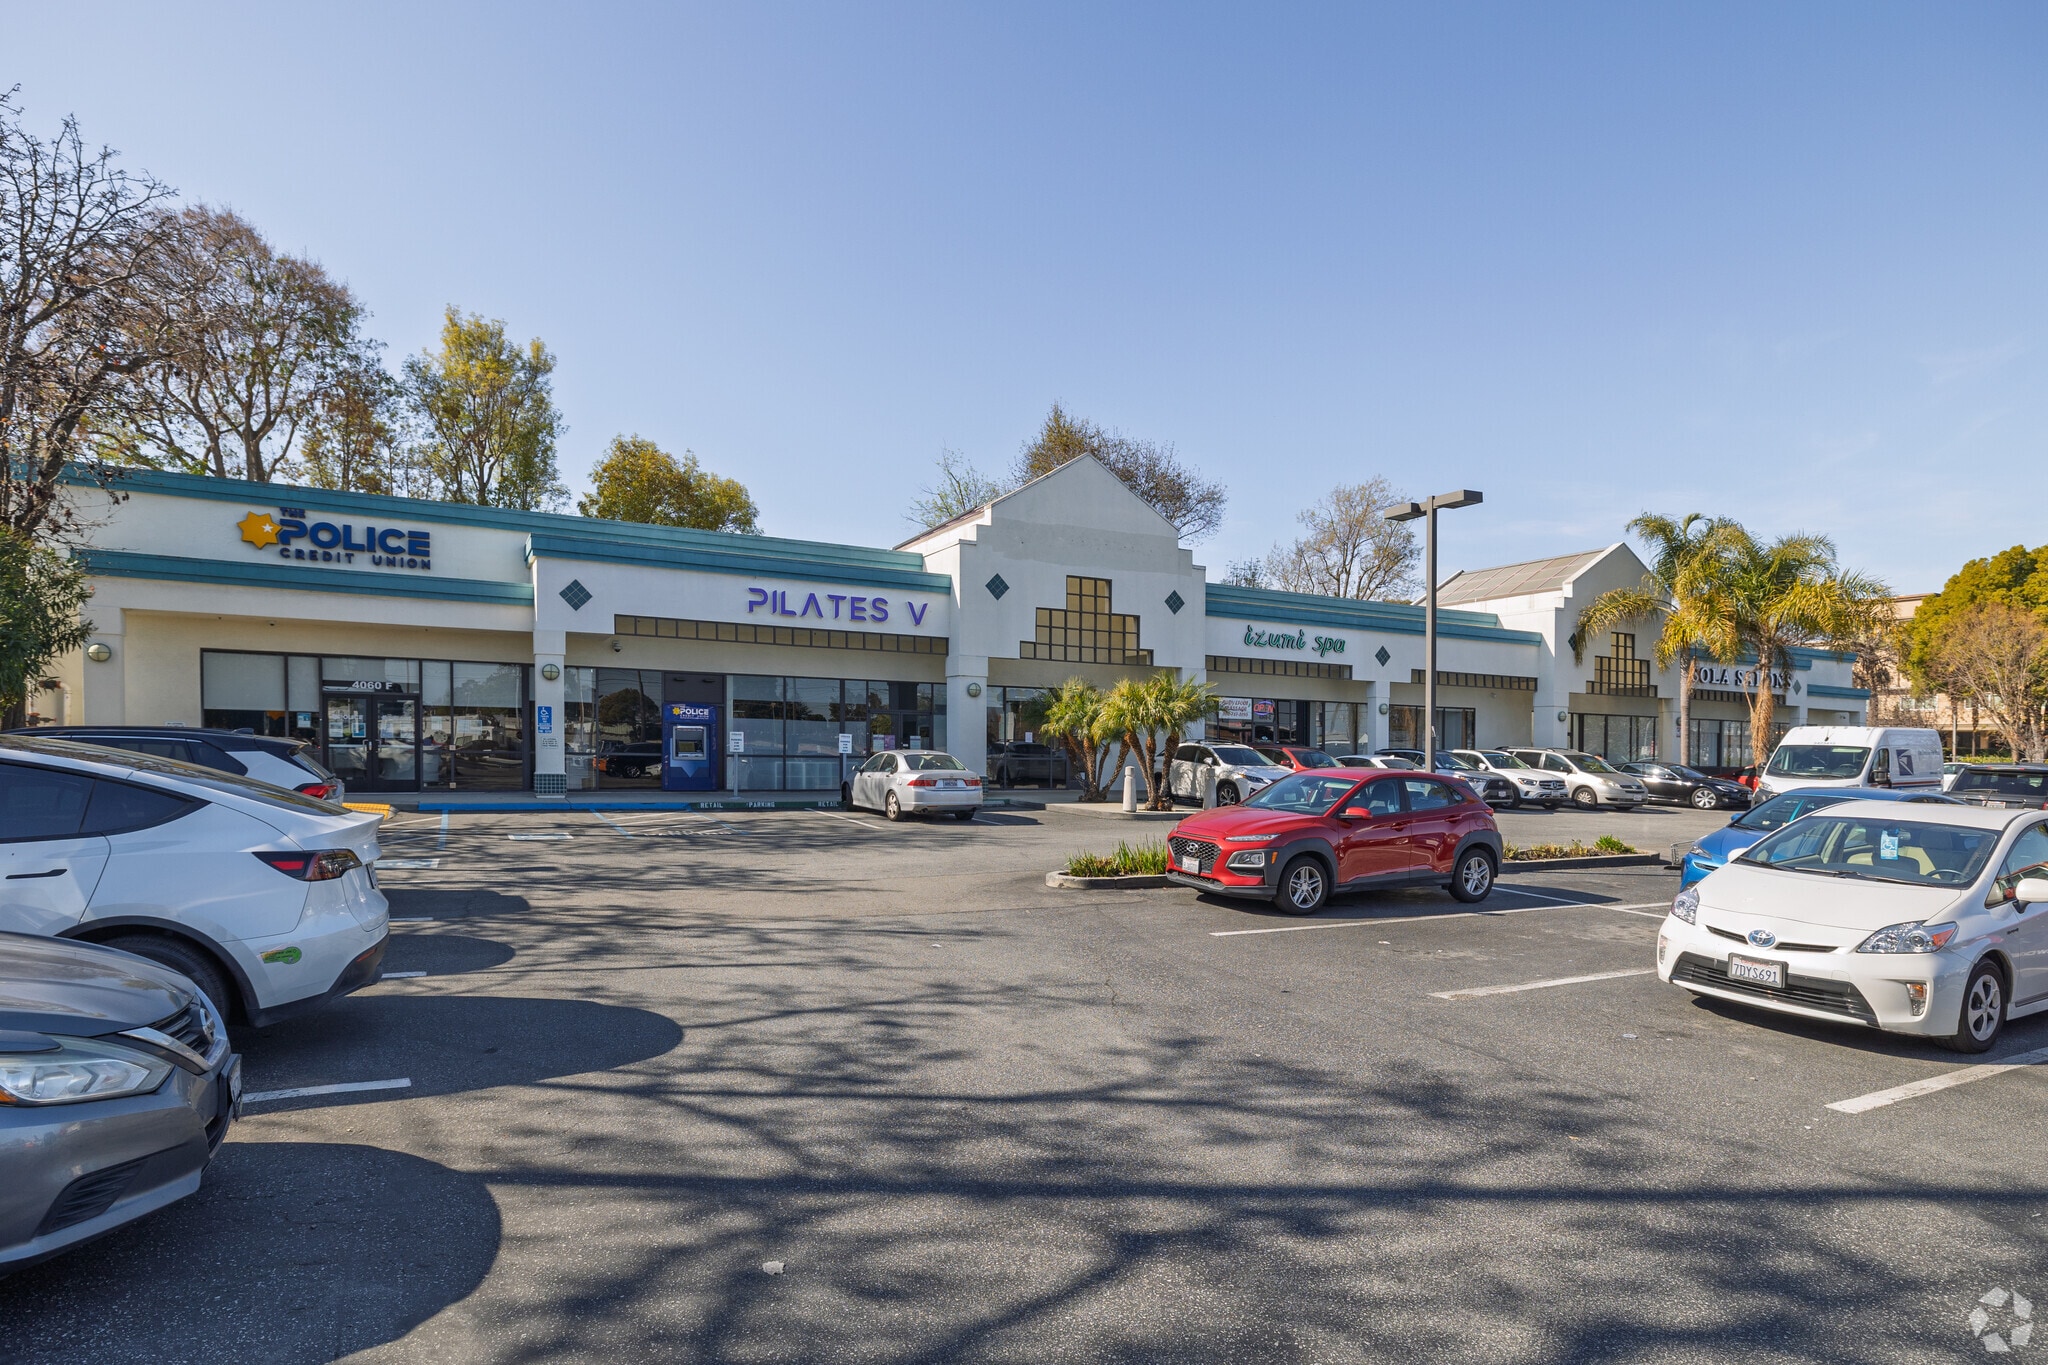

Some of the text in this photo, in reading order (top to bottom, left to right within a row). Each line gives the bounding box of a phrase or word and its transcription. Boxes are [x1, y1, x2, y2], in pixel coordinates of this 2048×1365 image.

[280, 507, 306, 518] THE
[279, 518, 430, 557] POLICE
[280, 547, 431, 570] CREDIT UNION
[748, 587, 928, 626] PILATES V
[1244, 624, 1346, 657] izumi spa
[352, 680, 382, 690] 4060
[680, 708, 709, 716] POLICE
[1253, 703, 1274, 713] OPEN
[1734, 963, 1778, 984] 7DYS691
